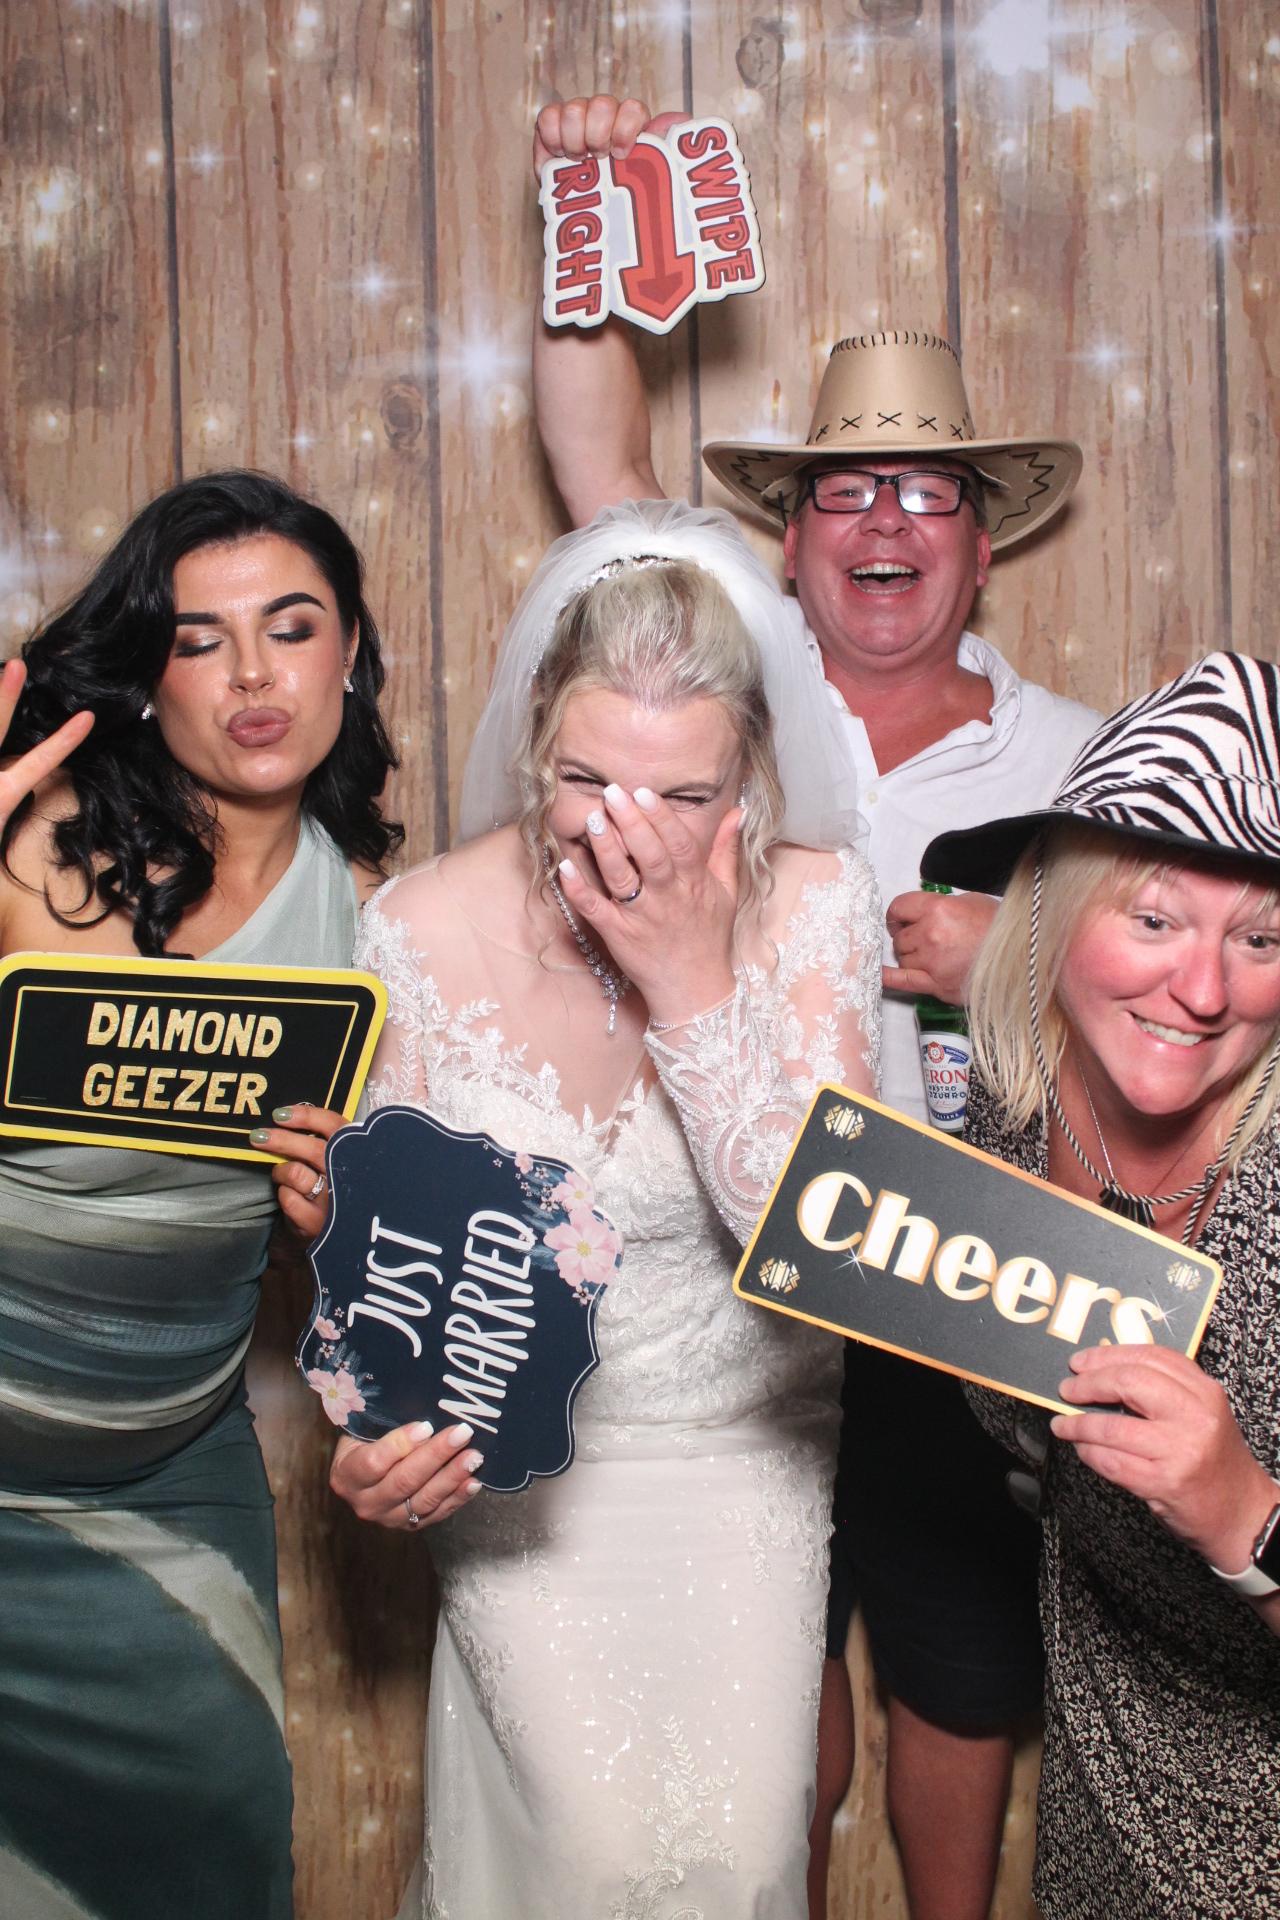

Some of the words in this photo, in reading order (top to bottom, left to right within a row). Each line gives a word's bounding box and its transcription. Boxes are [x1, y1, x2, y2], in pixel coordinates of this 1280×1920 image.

[552, 156, 603, 317] RIGHT
[677, 126, 756, 290] SWIPE
[82, 1063, 268, 1116] GEEZER
[86, 1002, 283, 1058] DIAMOND
[928, 1091, 967, 1099] ZZURRO
[347, 1215, 444, 1358] JUST
[438, 1210, 536, 1434] MARRIED
[796, 1171, 1163, 1345] Cheers
